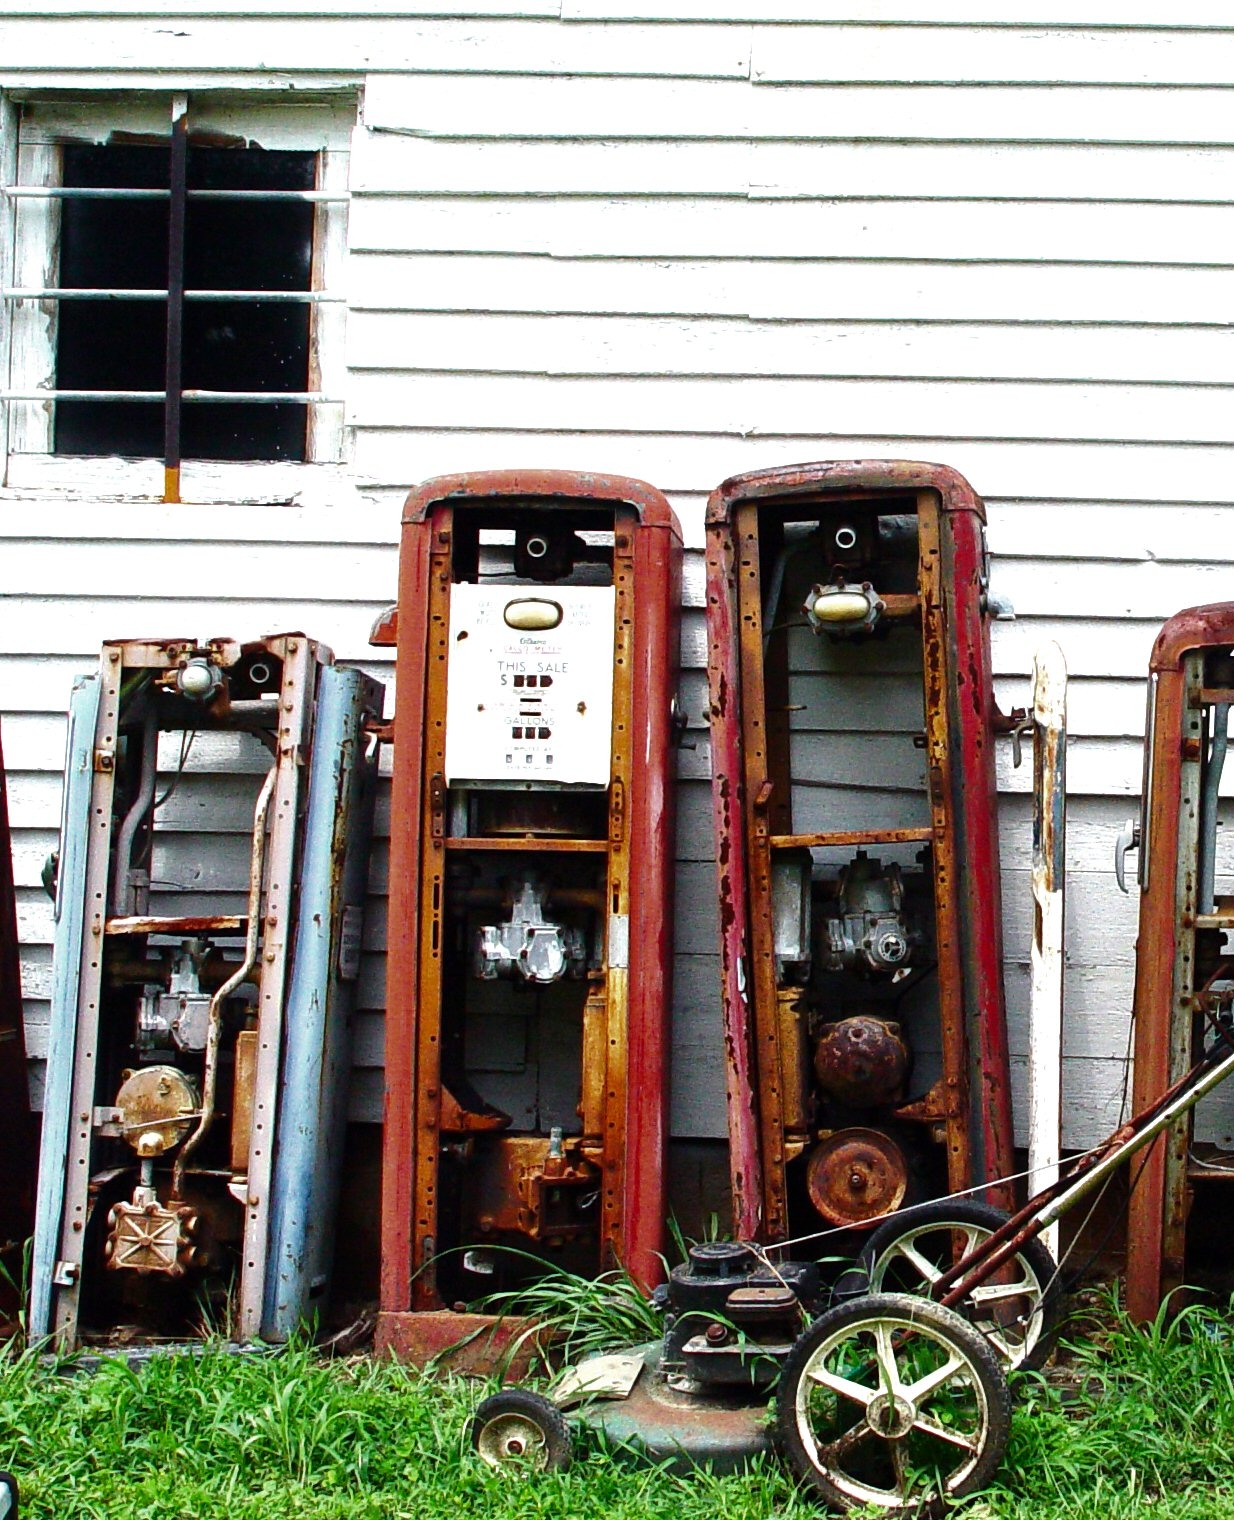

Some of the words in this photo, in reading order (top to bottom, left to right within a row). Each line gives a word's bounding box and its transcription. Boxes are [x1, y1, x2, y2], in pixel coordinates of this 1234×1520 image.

[497, 661, 526, 672] THIS
[537, 662, 569, 673] SALE
[505, 716, 555, 726] GALLONS
